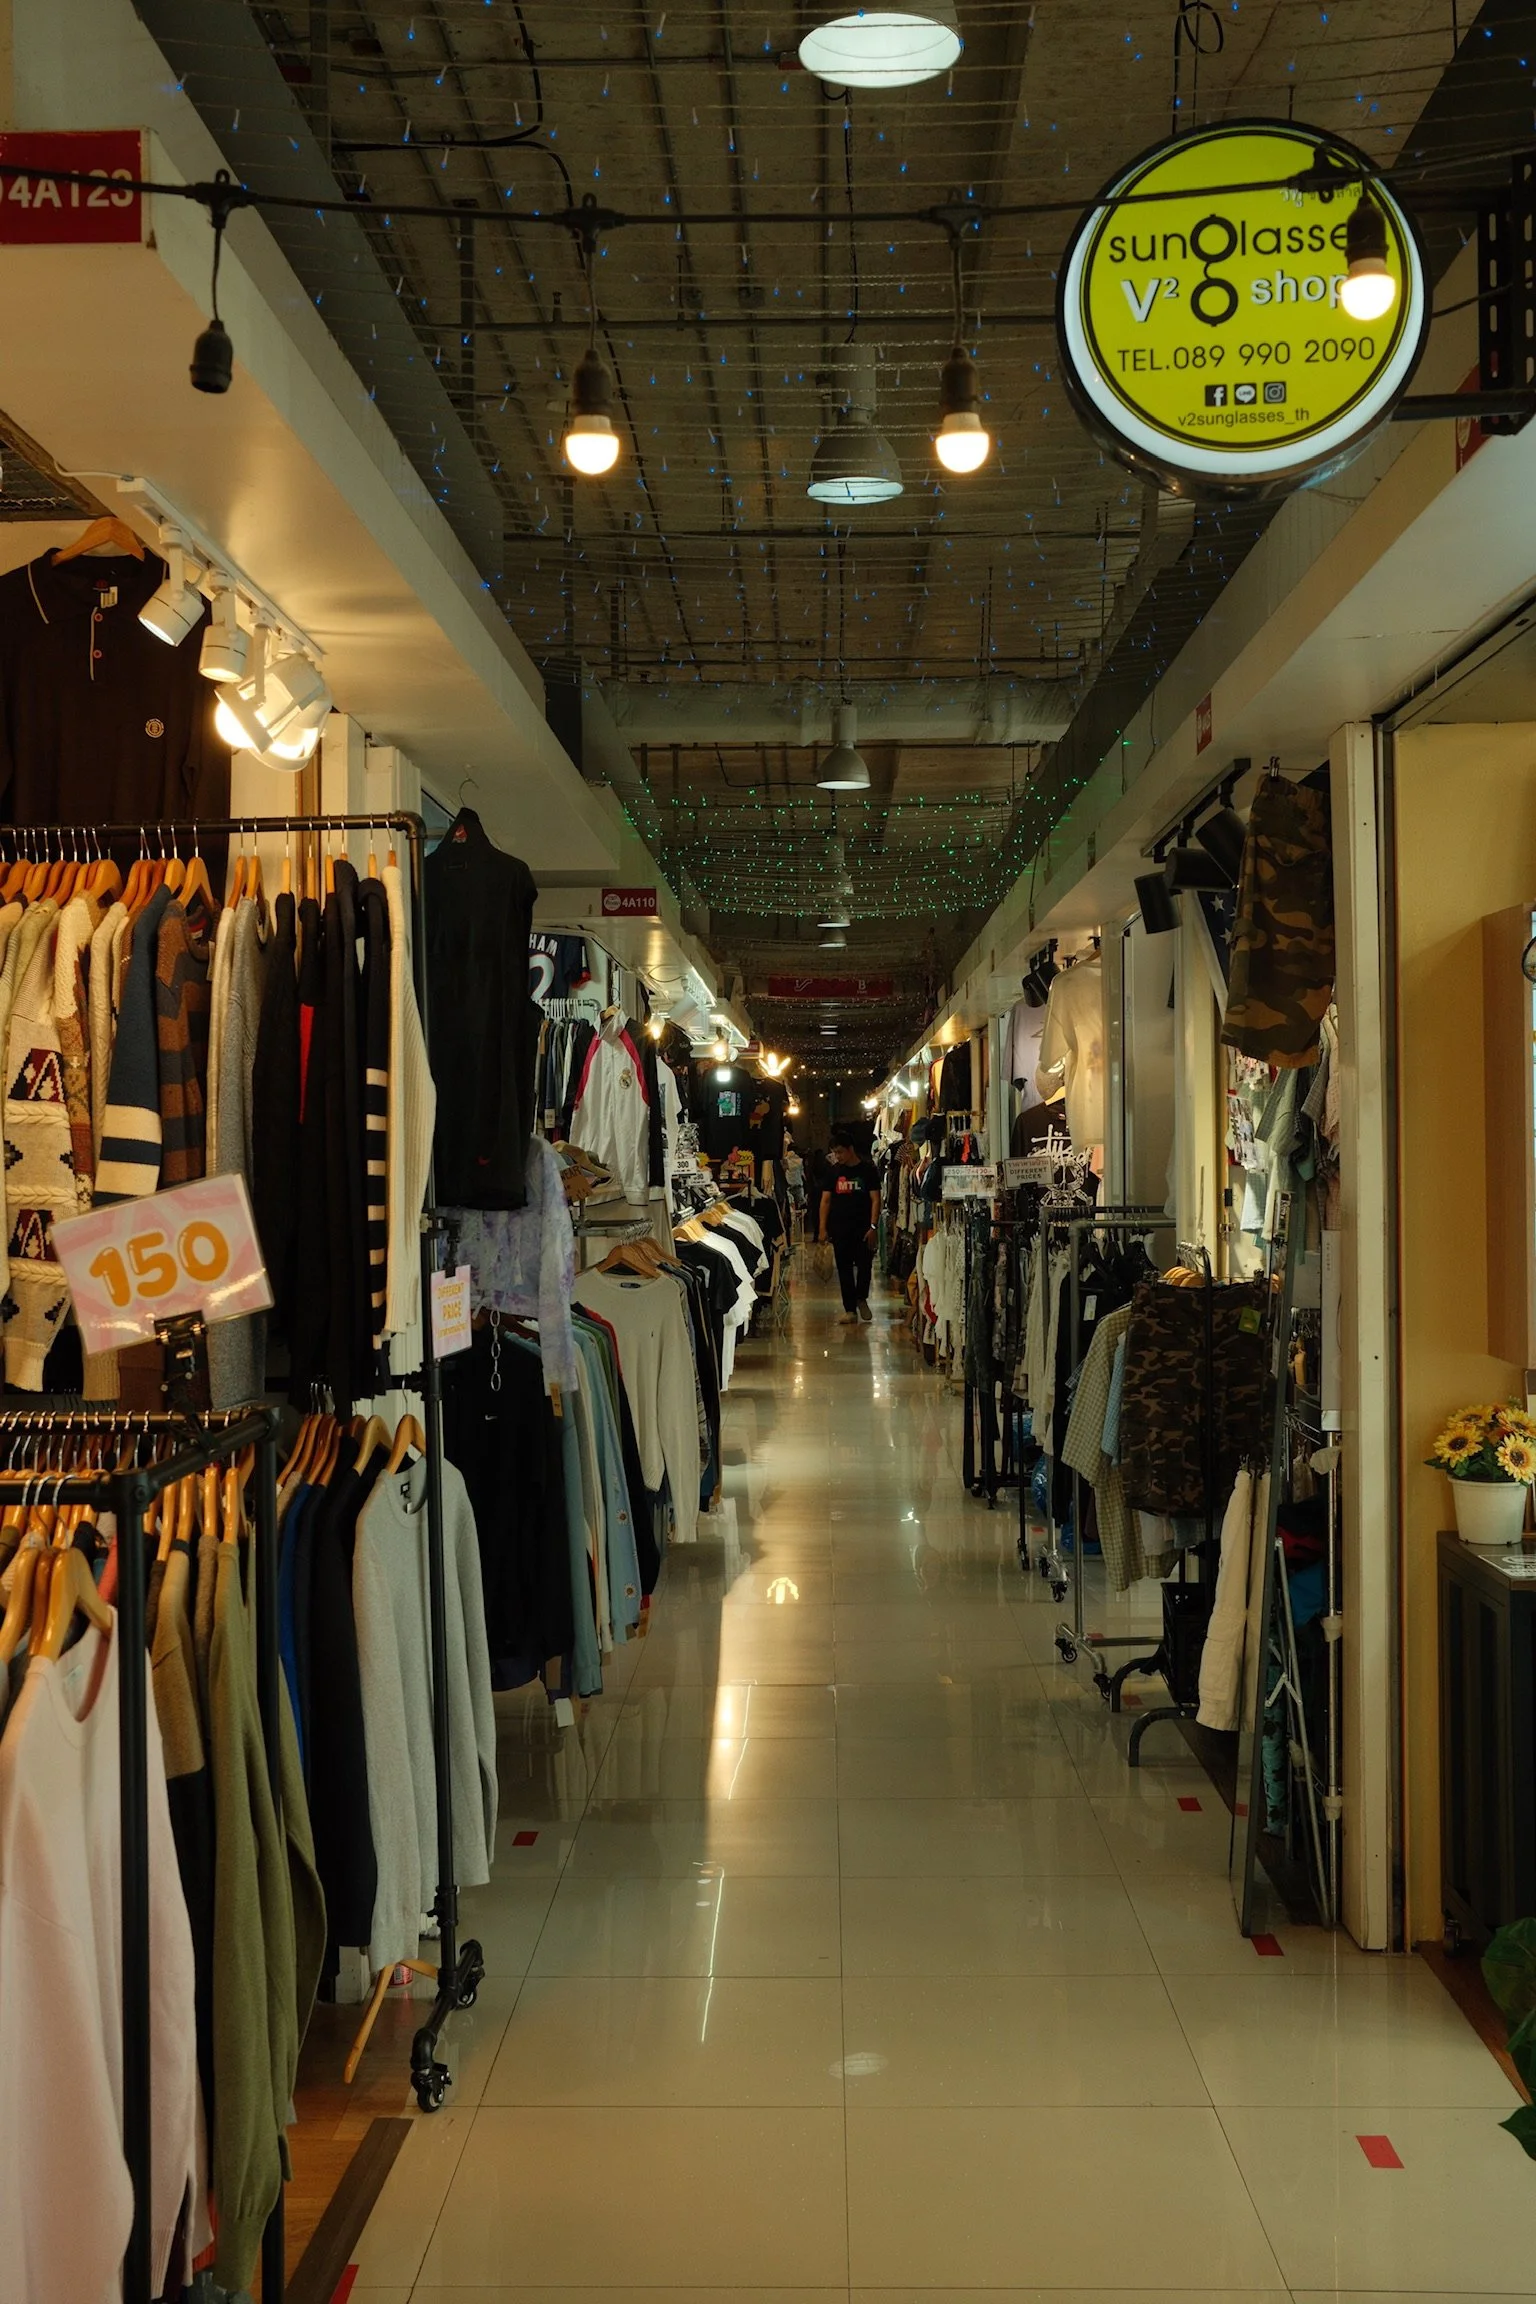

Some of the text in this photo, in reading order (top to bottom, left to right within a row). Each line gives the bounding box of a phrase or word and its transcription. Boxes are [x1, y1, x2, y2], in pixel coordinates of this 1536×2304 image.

[1251, 270, 1348, 309] shop
[1117, 337, 1375, 372] TEL.089 990 2090
[1178, 408, 1310, 428] v2sunglasses_th
[622, 897, 656, 908] 4A110
[528, 933, 558, 957] HAM
[677, 1161, 689, 1169] 300
[1010, 1167, 1047, 1175] DIFFERENT
[89, 1221, 230, 1307] 150
